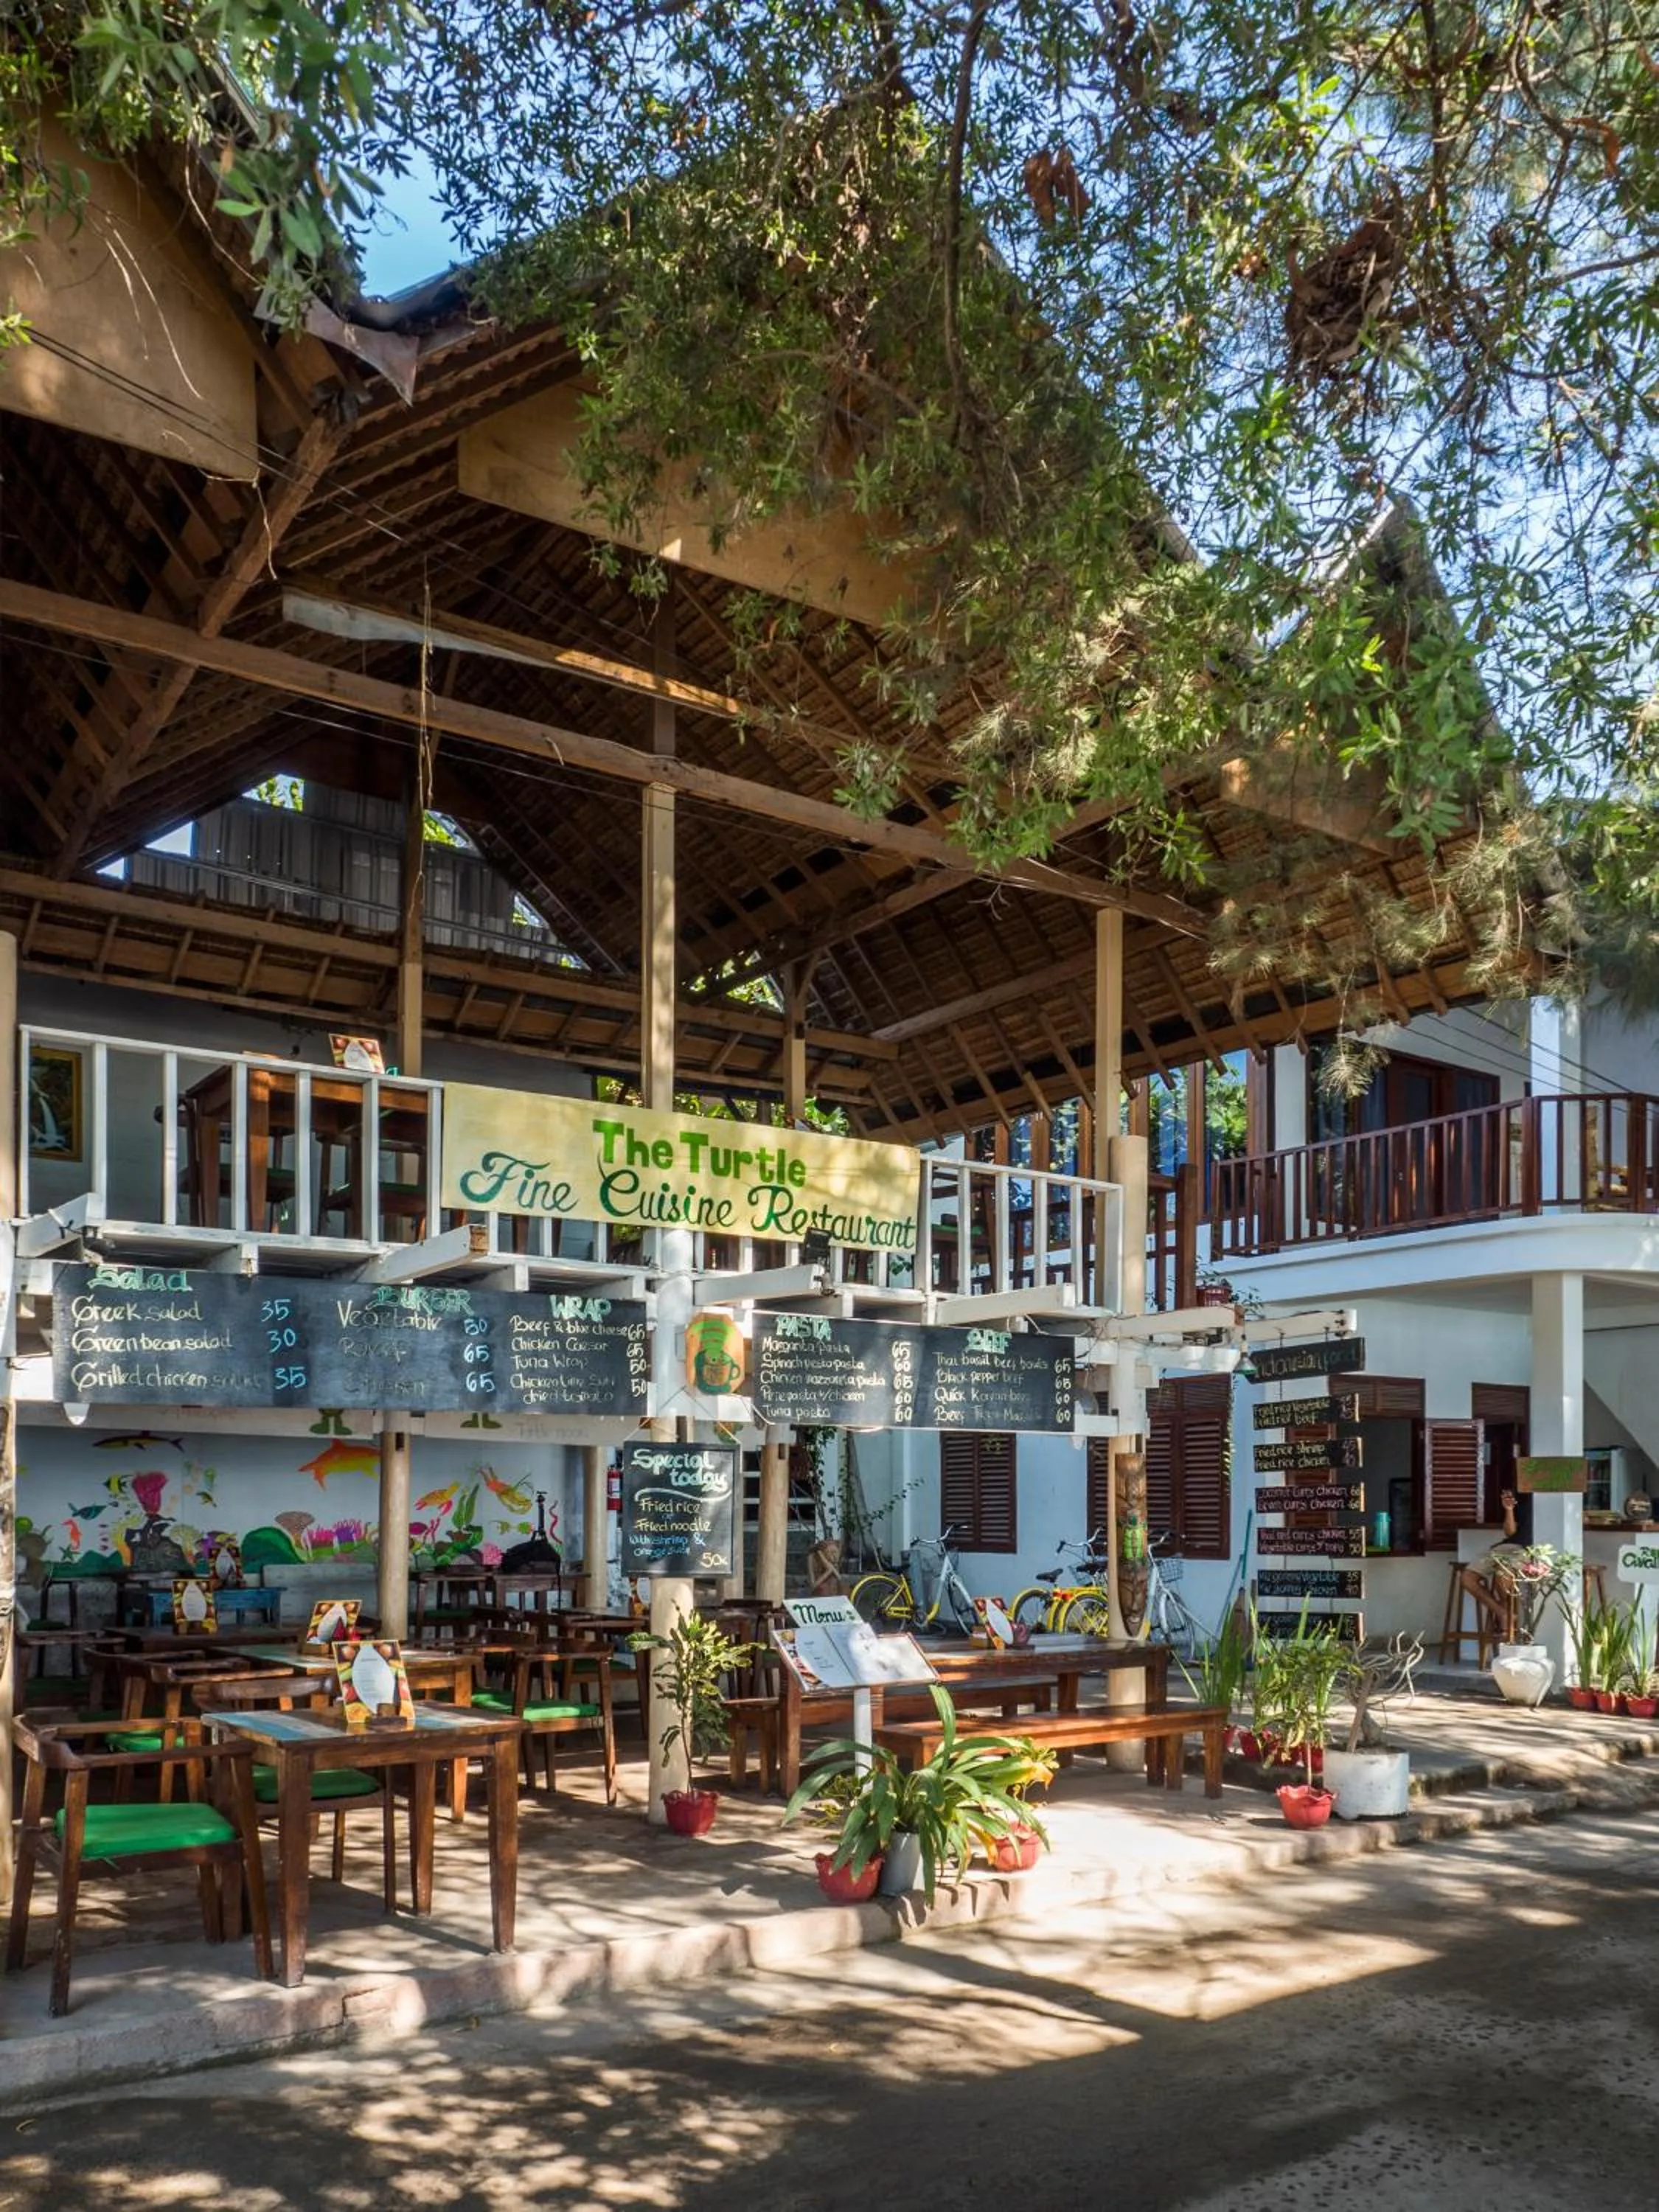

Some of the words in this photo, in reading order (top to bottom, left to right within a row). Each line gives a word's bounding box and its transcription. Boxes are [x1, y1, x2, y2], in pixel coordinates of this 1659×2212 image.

[592, 1119, 673, 1169] The
[679, 1132, 806, 1187] Turtle
[459, 1150, 579, 1213] Fine
[598, 1149, 738, 1227] Cuisine
[746, 1183, 918, 1251] Restaurant
[87, 1264, 194, 1292] Salad
[72, 1294, 142, 1328] Greek
[260, 1298, 291, 1322] 35
[549, 1295, 611, 1324] WRAP
[509, 1315, 551, 1337] Beef
[627, 1324, 645, 1341] 65
[776, 1315, 832, 1341] PASTA
[267, 1329, 296, 1353] 30
[511, 1336, 560, 1352] Chicken
[626, 1343, 644, 1358] 65
[891, 1340, 912, 1360] 65
[463, 1343, 490, 1363] 65
[510, 1354, 549, 1370] Tuna
[629, 1358, 647, 1375] 50
[893, 1360, 911, 1372] 60
[1054, 1357, 1071, 1374] 65
[274, 1366, 307, 1389] 35
[465, 1371, 496, 1393] 65
[630, 1378, 647, 1397] 50
[892, 1372, 914, 1390] 65
[1054, 1375, 1072, 1390] 65
[894, 1391, 912, 1405] 60
[1054, 1391, 1071, 1405] 60
[894, 1405, 913, 1423] 60
[1055, 1408, 1071, 1425] 60
[631, 1448, 715, 1475] Special
[669, 1468, 728, 1493] today
[639, 1497, 673, 1514] Fried
[675, 1501, 701, 1513] rice
[634, 1518, 669, 1532] Fried
[669, 1517, 712, 1532] noodle
[693, 1531, 706, 1546] &
[793, 1603, 846, 1624] Menu
